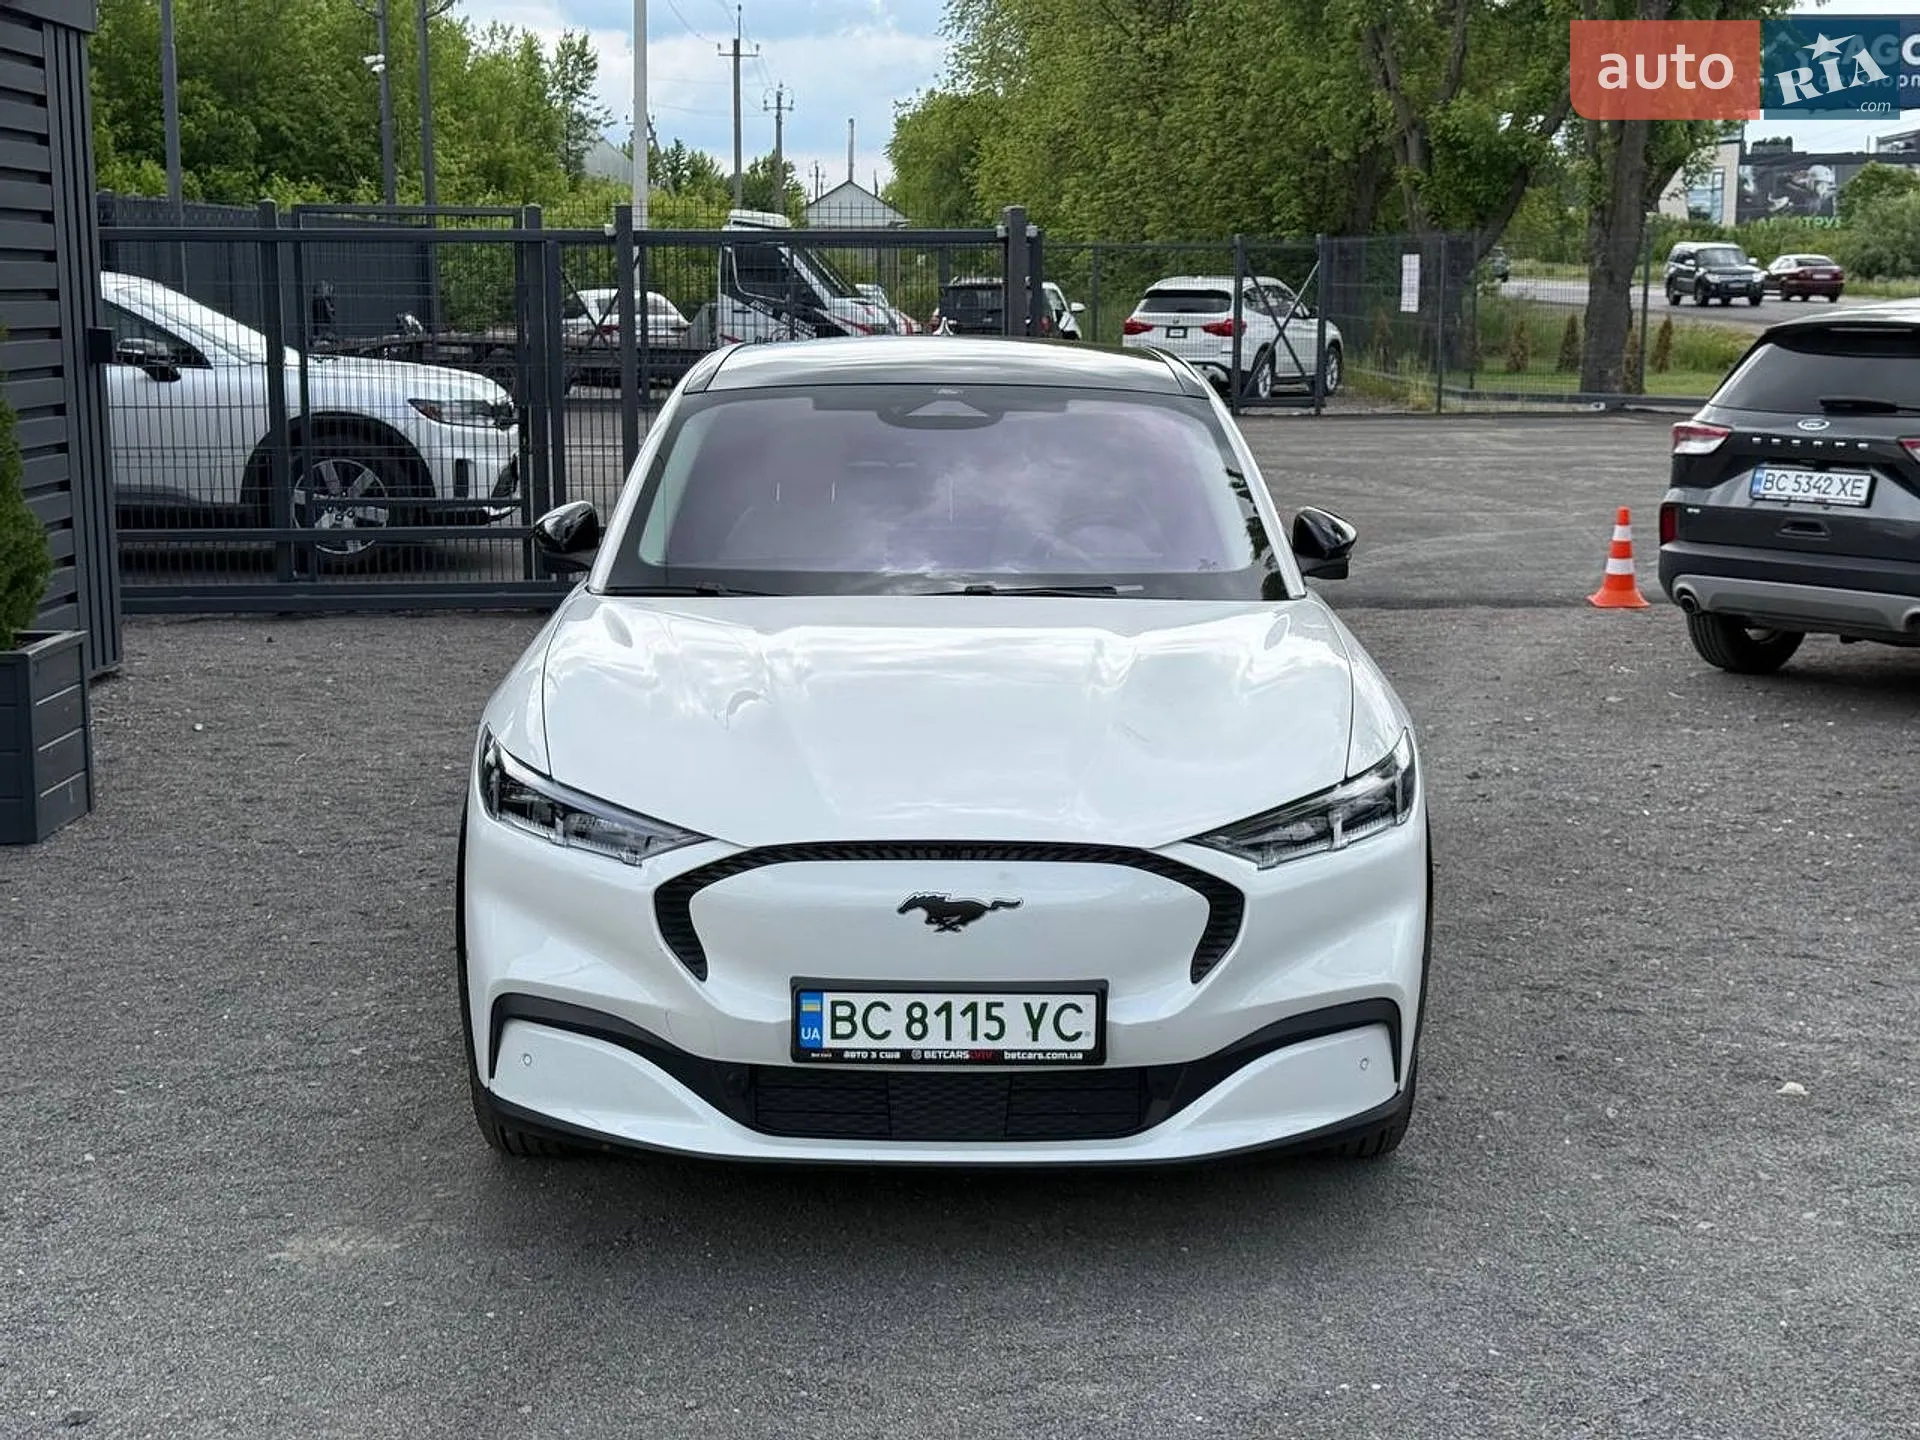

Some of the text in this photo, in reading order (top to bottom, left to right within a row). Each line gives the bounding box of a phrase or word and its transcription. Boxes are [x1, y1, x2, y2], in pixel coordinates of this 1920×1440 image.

[1763, 473, 1864, 498] BC 5342 XE
[829, 999, 1084, 1043] BC 8115 YC
[801, 1028, 820, 1041] UA
